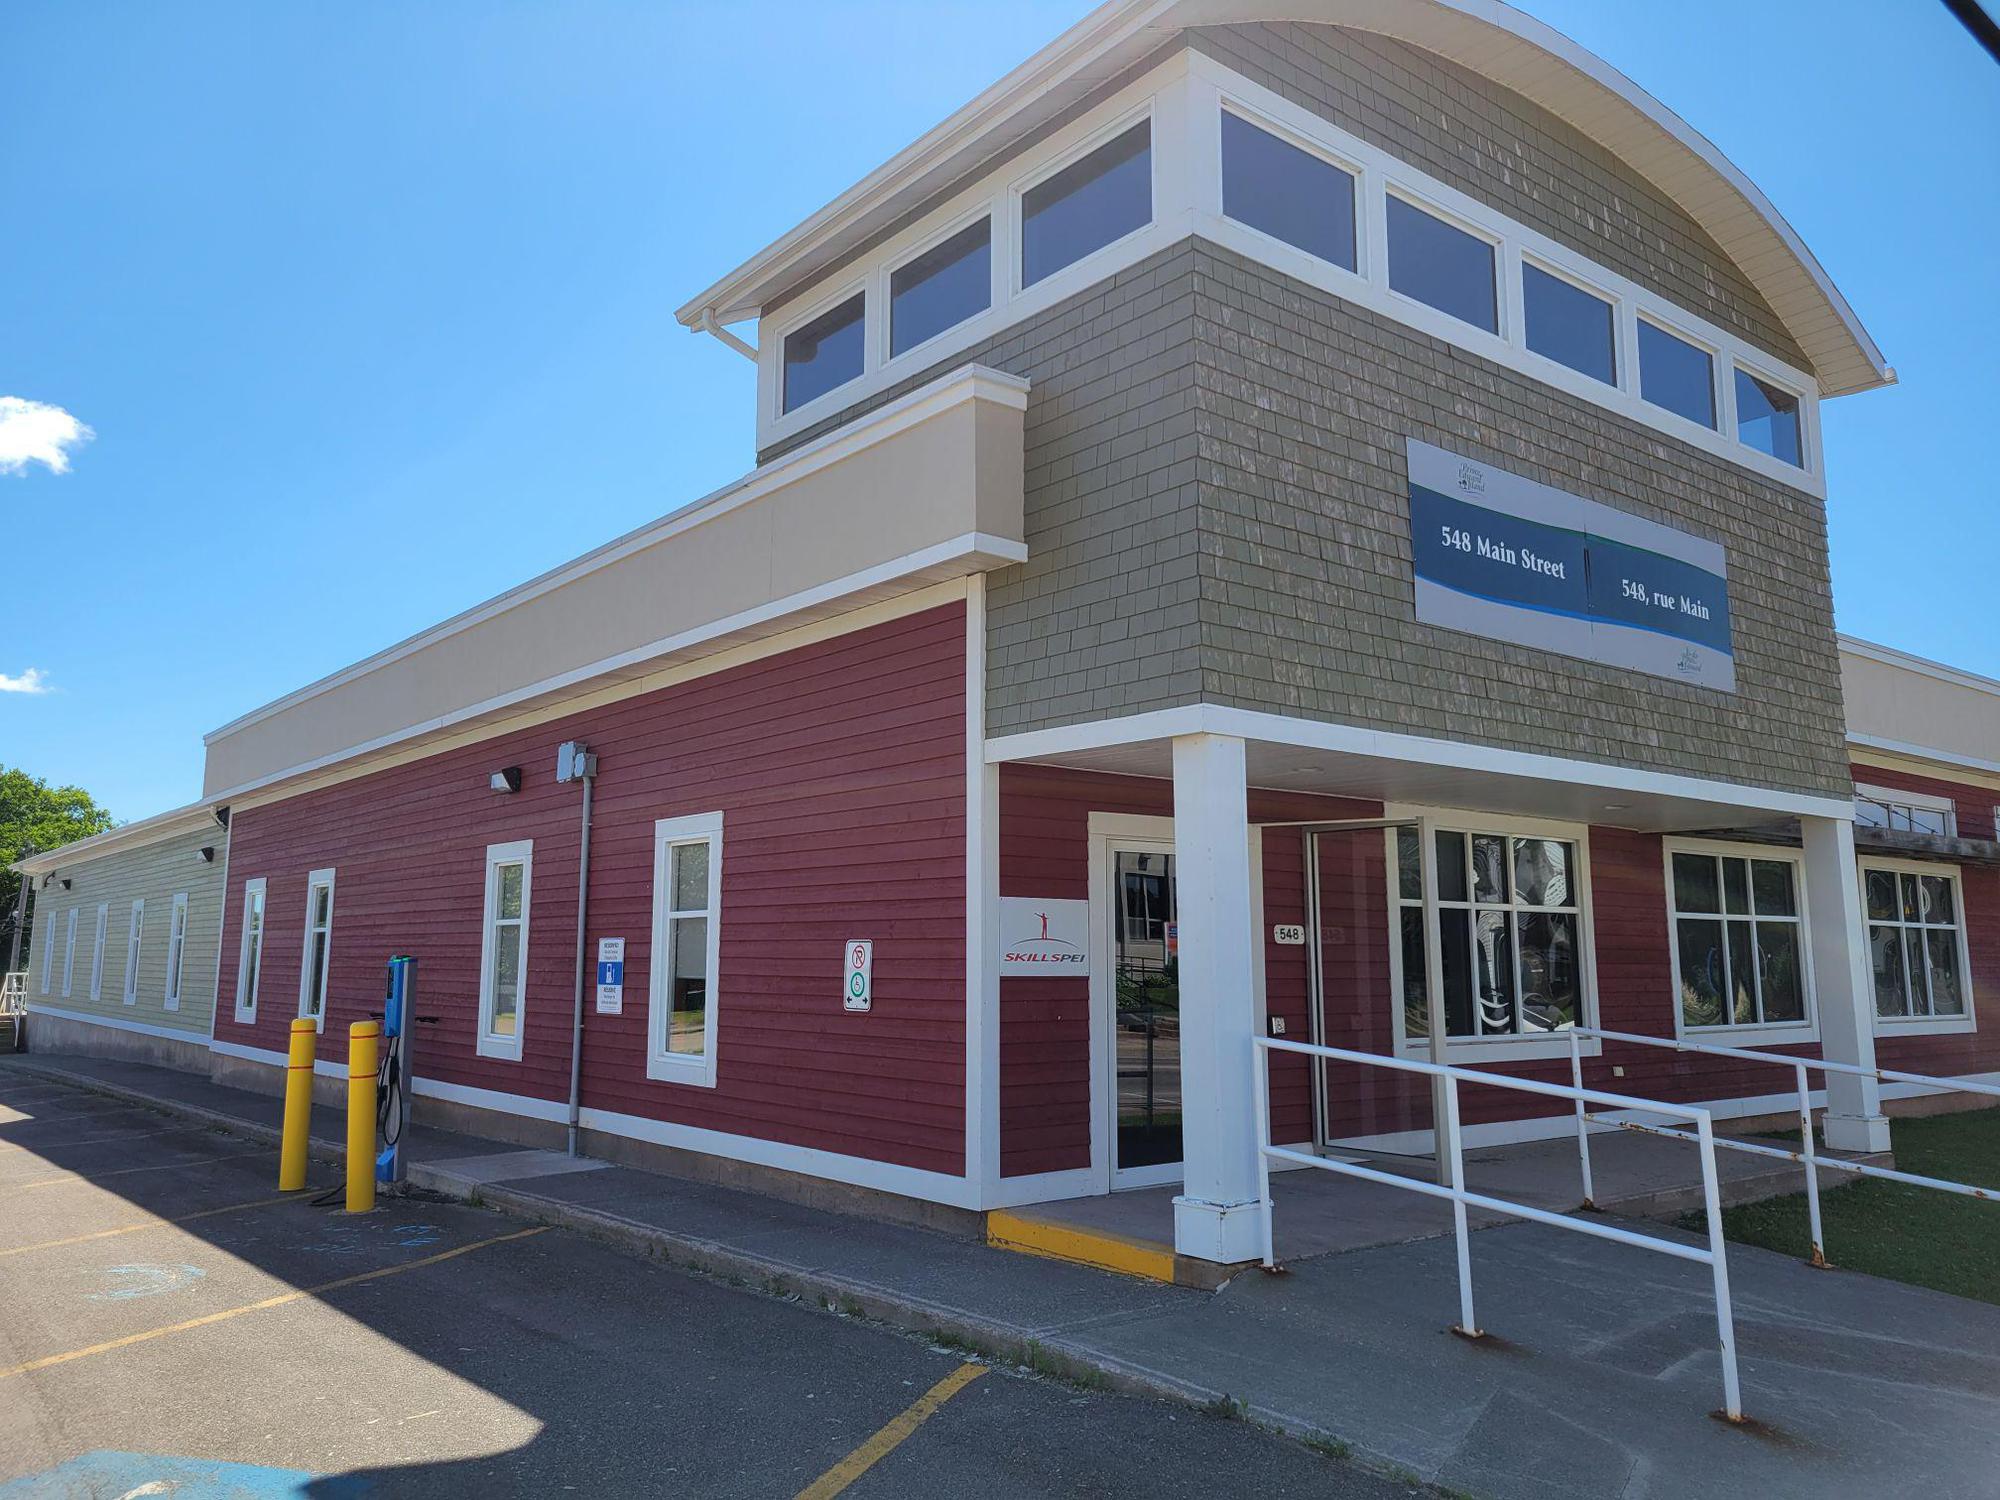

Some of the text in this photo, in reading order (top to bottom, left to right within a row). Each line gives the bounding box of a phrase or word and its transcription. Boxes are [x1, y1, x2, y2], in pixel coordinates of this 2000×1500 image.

[1441, 526, 1566, 580] 548 Main Street
[1622, 579, 1710, 620] 548, rue Main
[1280, 928, 1299, 940] 548
[1004, 952, 1086, 963] SKILLSPEI
